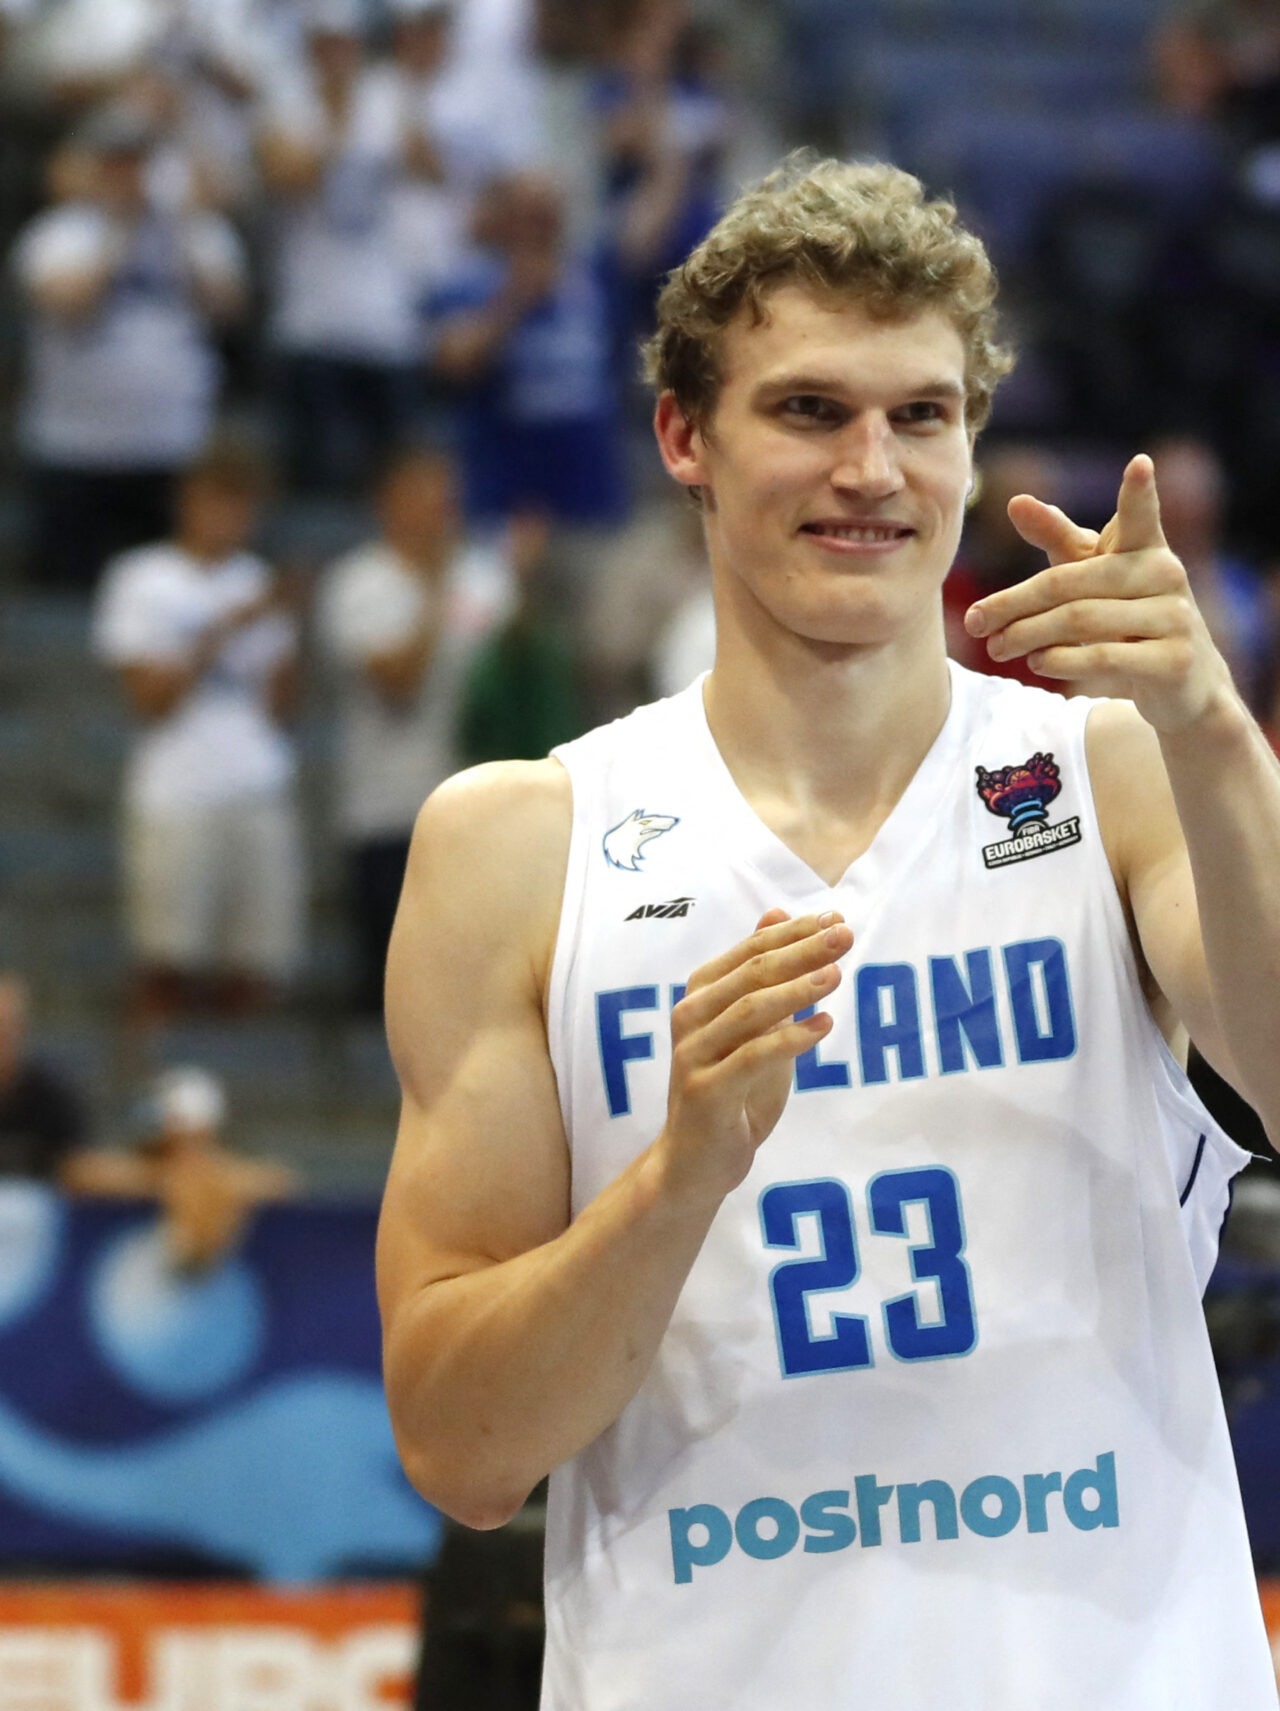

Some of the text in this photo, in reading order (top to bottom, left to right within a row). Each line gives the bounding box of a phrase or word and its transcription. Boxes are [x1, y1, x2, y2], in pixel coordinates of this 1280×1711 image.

[985, 818, 1078, 861] EUROBASKET
[1022, 824, 1041, 836] FIBA
[623, 900, 690, 921] AVIA
[594, 935, 1079, 1119] FLAND
[757, 1163, 979, 1380] 23
[668, 1450, 1120, 1585] postnord
